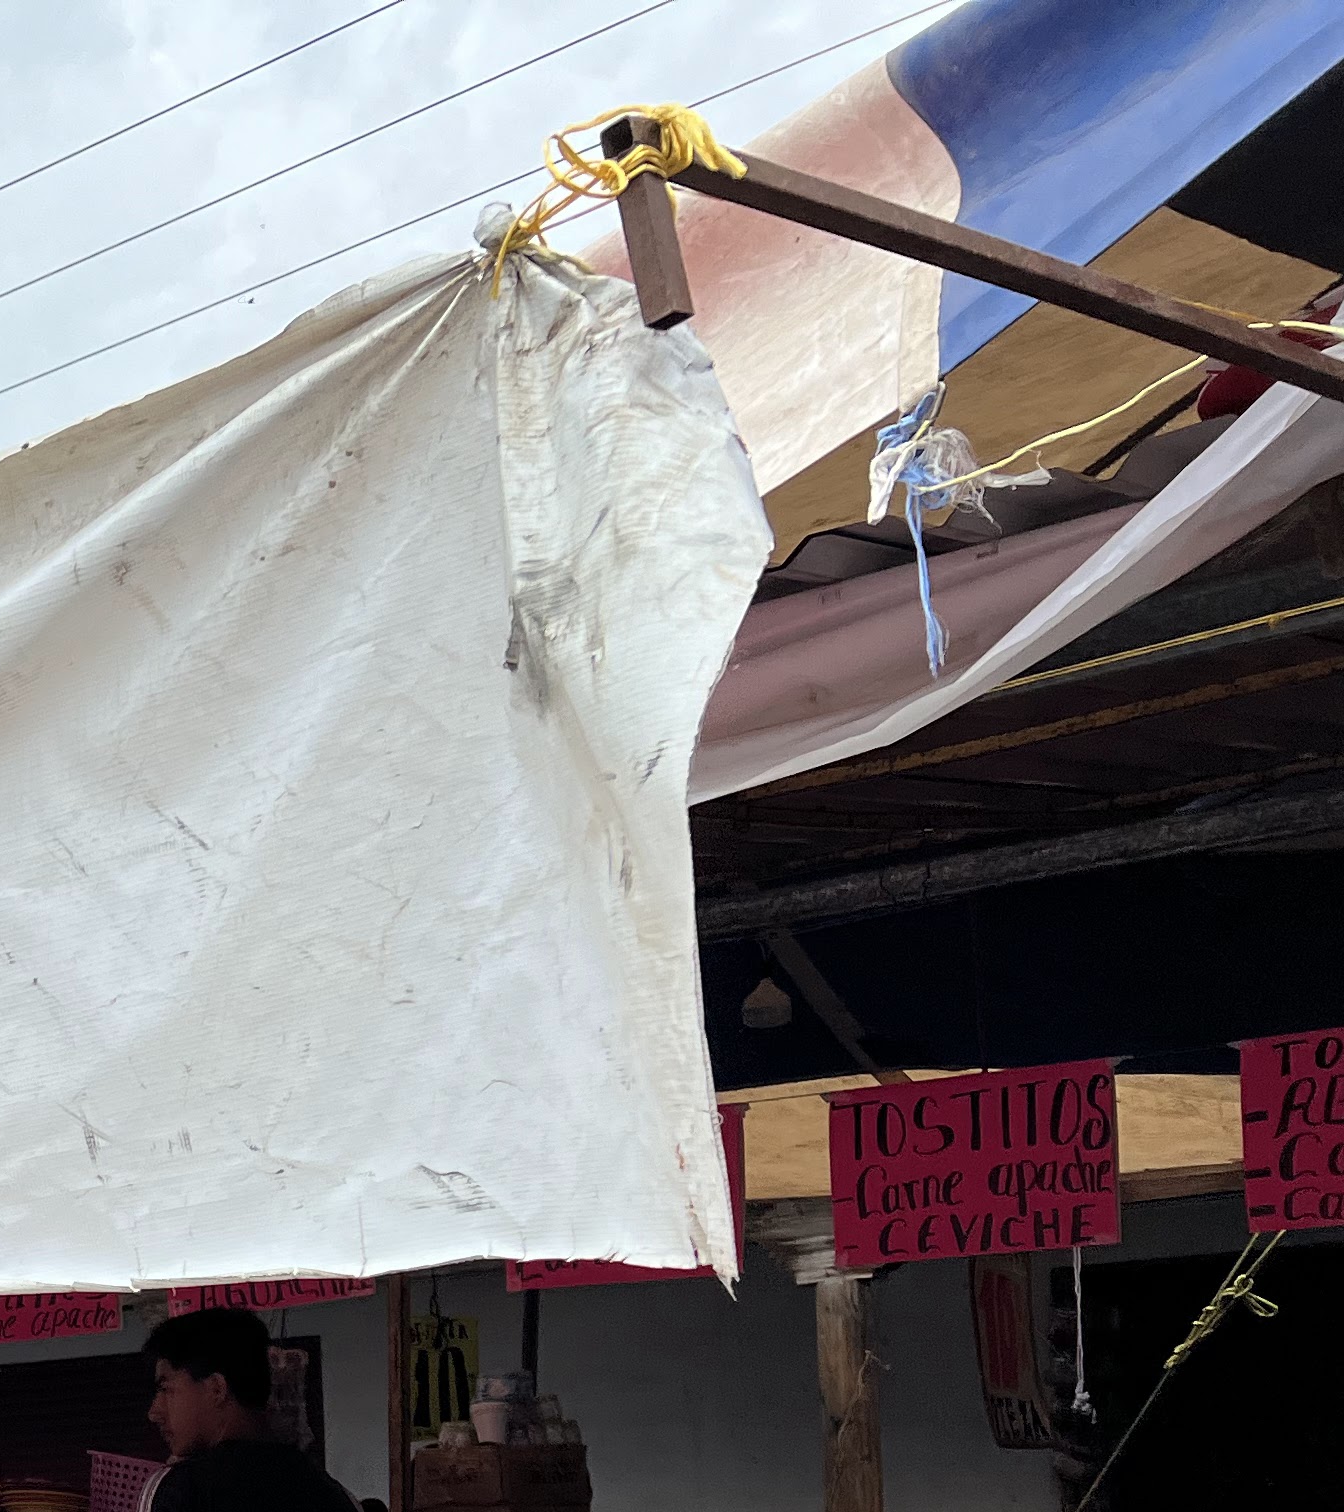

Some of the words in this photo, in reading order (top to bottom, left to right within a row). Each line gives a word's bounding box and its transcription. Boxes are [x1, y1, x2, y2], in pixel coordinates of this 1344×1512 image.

[832, 1074, 1111, 1160] TOSTITOS
[856, 1164, 963, 1220] Carne
[987, 1146, 1112, 1217] apache
[878, 1203, 1096, 1257] CEVICHE
